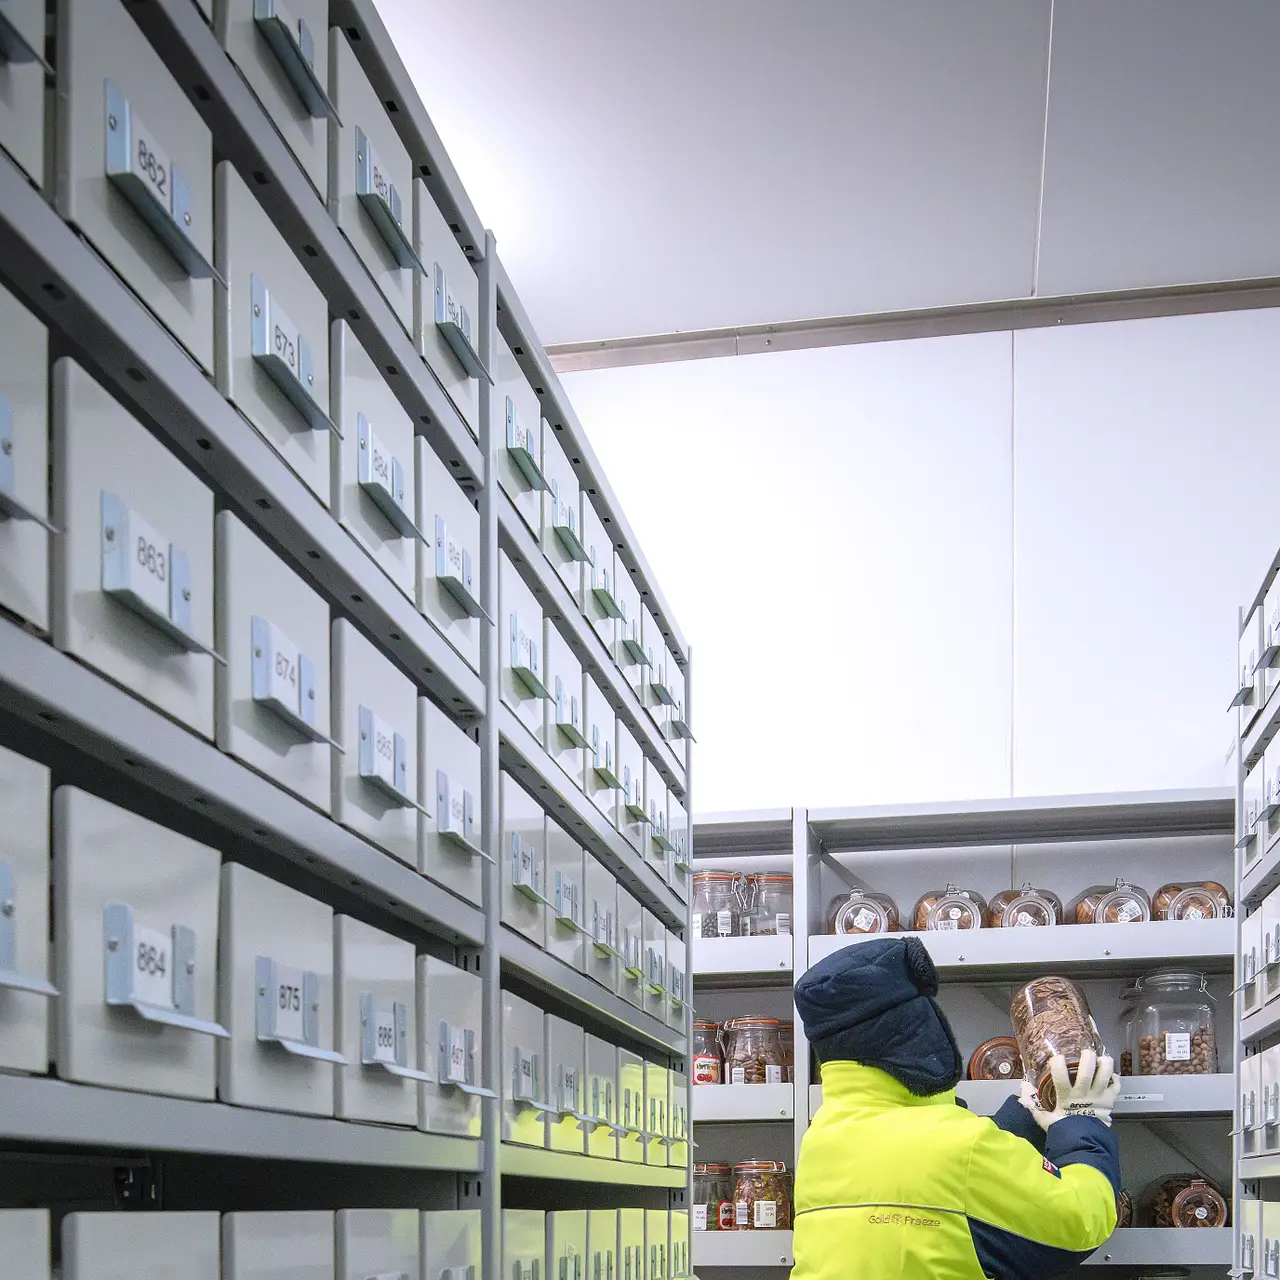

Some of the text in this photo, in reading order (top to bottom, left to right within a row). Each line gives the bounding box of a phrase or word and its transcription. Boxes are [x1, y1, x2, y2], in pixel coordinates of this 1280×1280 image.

[138, 139, 168, 197] 862
[274, 325, 297, 368] 873
[137, 941, 167, 978] 864
[278, 983, 302, 1013] 875
[868, 1213, 890, 1224] Gold
